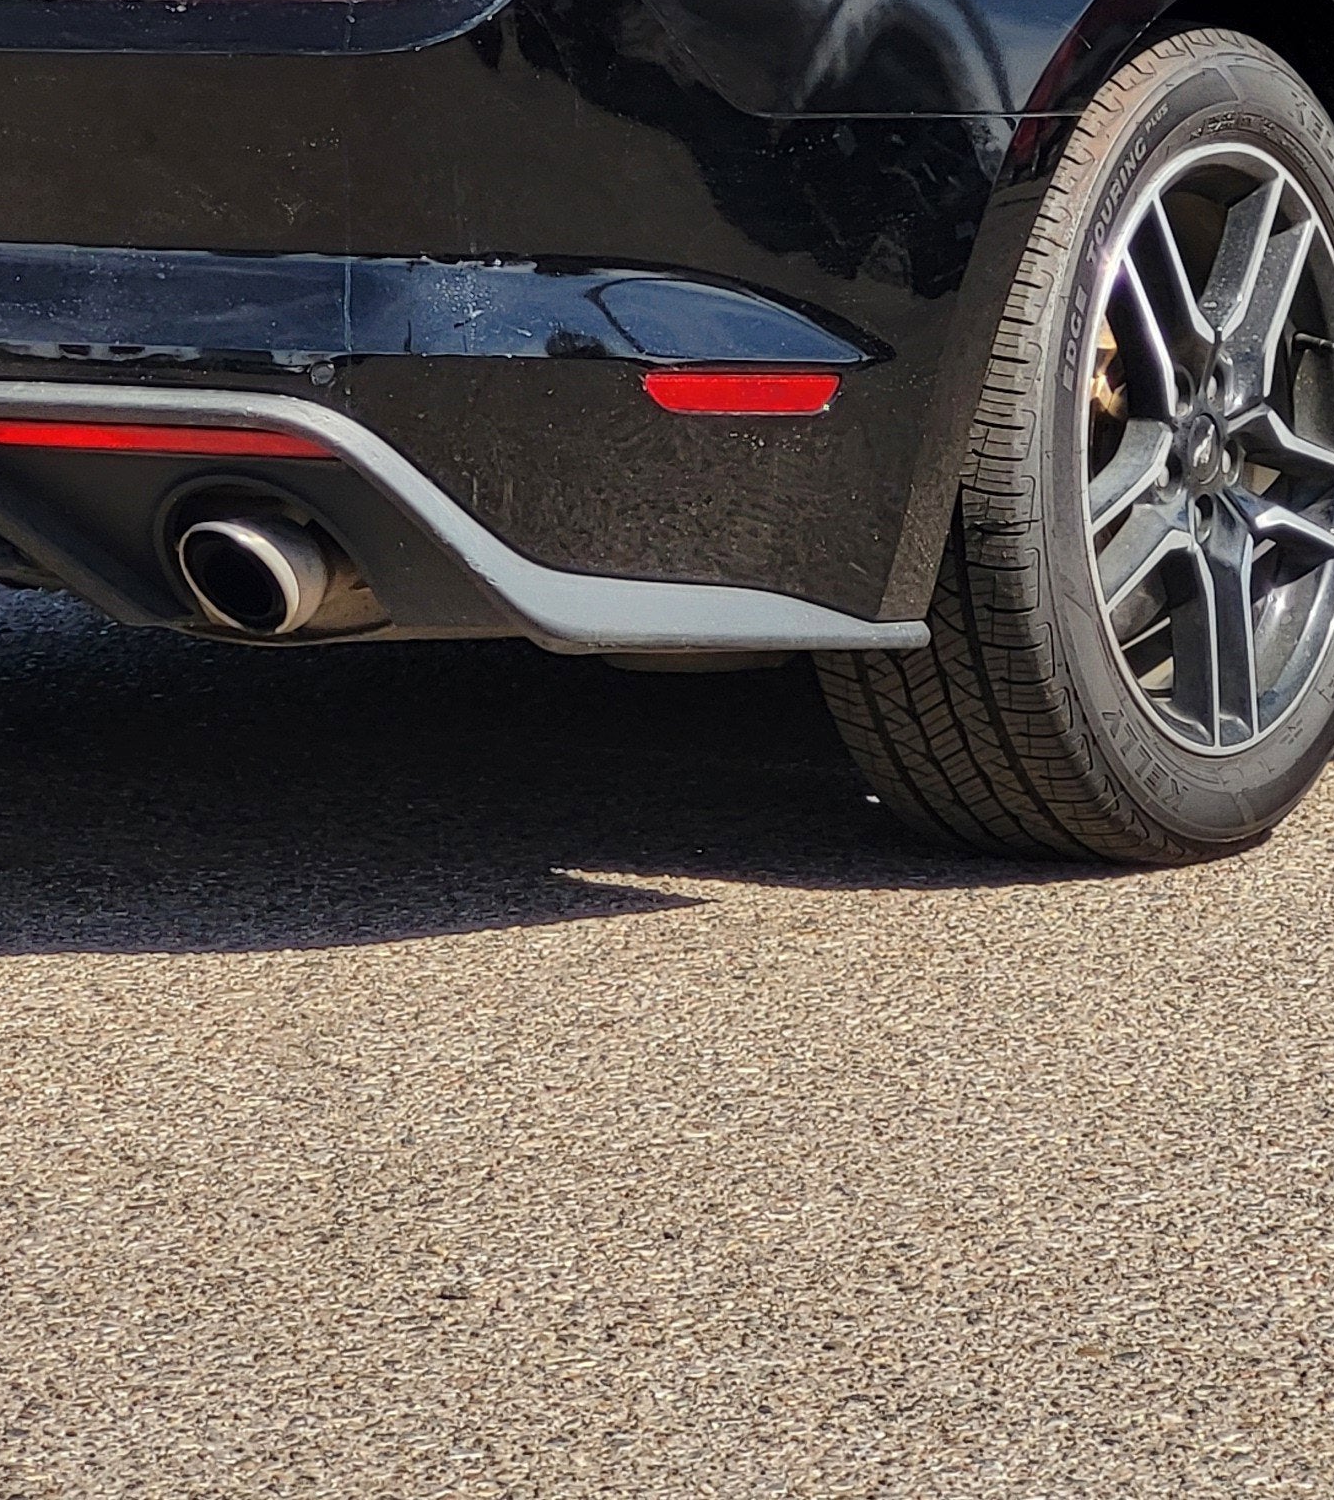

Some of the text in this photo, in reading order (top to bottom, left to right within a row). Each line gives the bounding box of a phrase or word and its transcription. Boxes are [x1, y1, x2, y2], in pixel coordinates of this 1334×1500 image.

[1062, 103, 1170, 392] EDGE TOURING PLUS
[1101, 708, 1189, 813] KELLY
